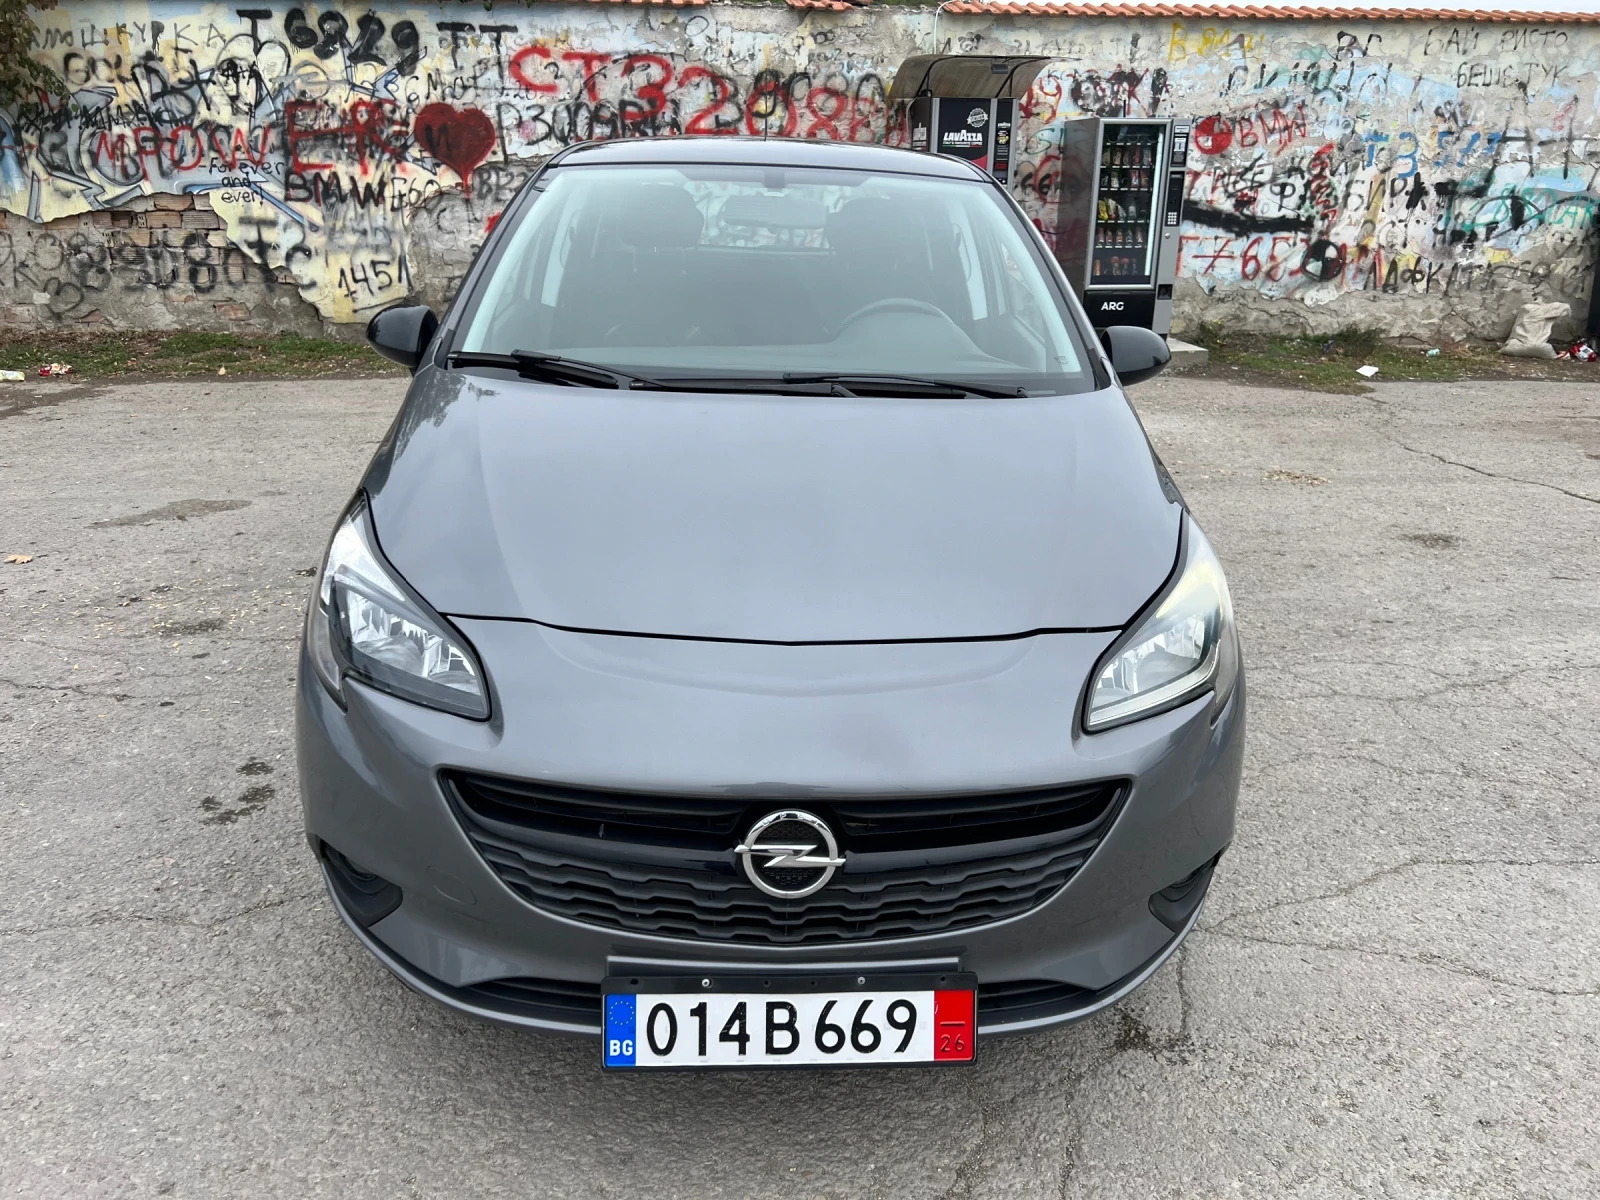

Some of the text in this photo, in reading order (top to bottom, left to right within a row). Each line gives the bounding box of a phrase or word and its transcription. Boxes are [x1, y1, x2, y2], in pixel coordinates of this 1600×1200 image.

[943, 129, 983, 142] LAVAZZA
[221, 171, 251, 188] and
[284, 171, 386, 210] BMW
[1101, 302, 1125, 311] ARG
[609, 1039, 633, 1057] BG
[941, 1033, 965, 1052] 26
